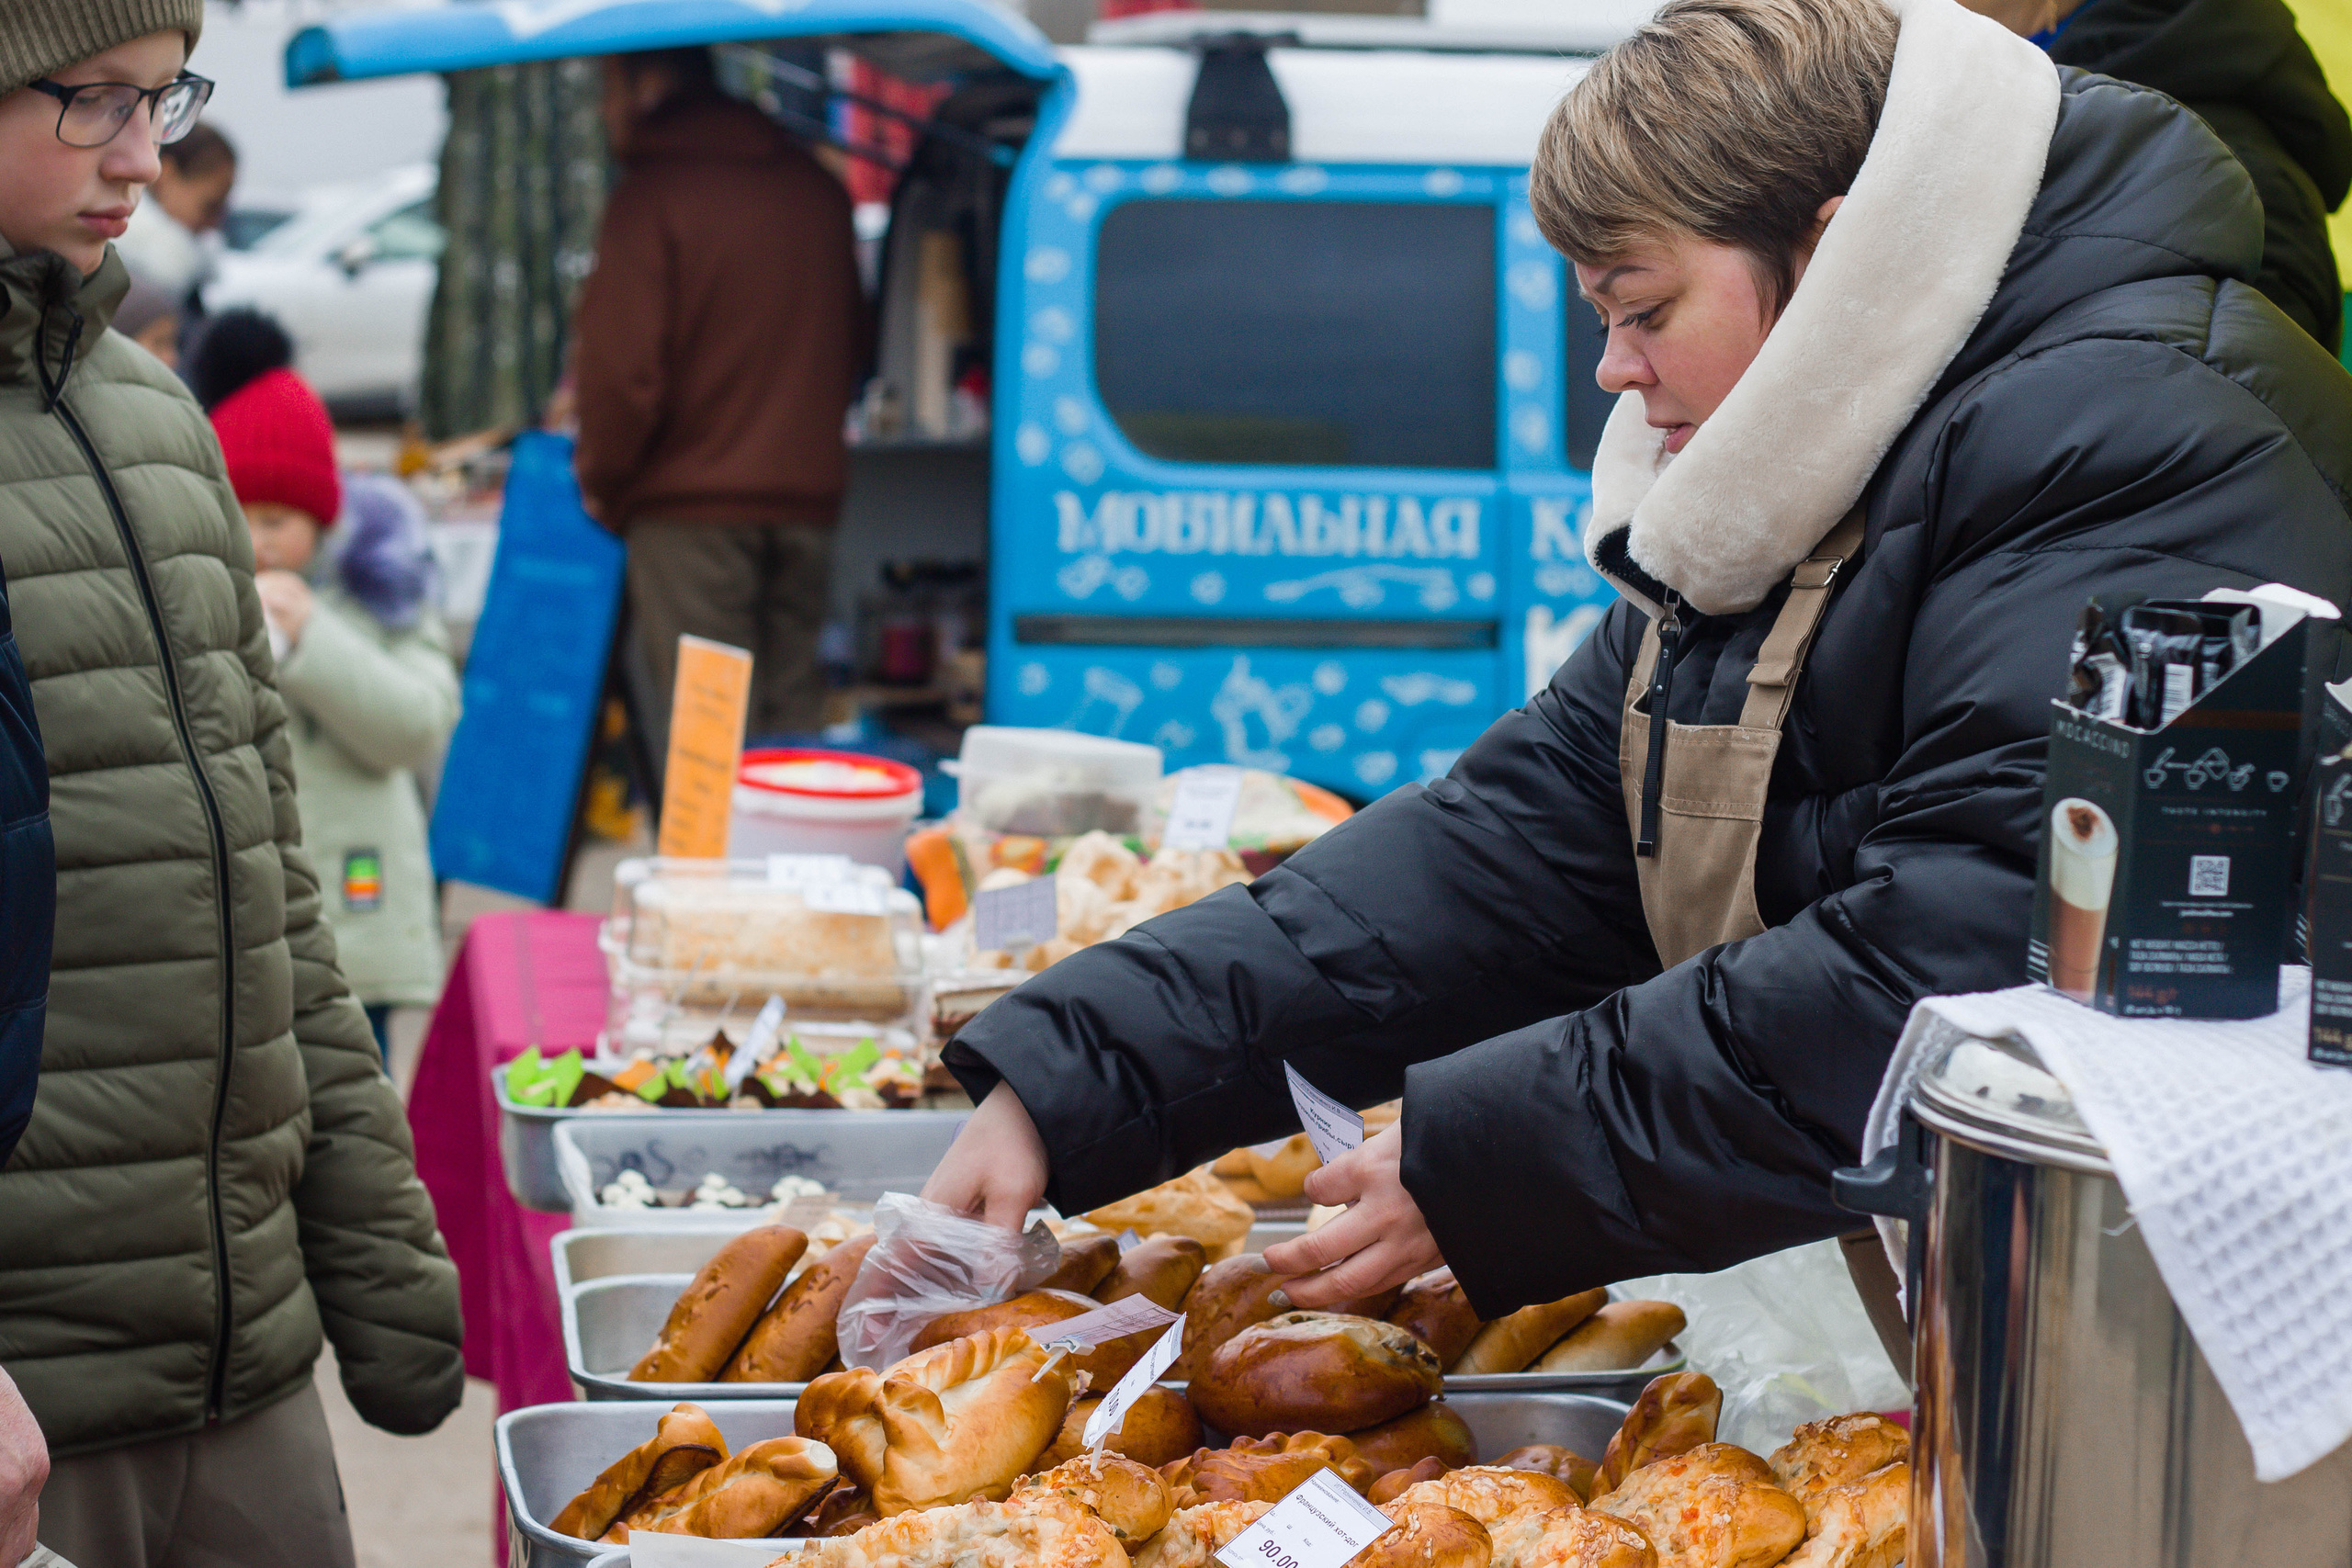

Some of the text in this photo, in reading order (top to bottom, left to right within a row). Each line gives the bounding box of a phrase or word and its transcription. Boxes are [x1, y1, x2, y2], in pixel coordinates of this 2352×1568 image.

[1055, 491, 1481, 556] МОБИЛЬНАЯ
[1295, 1494, 1360, 1548] Французский хот-дог
